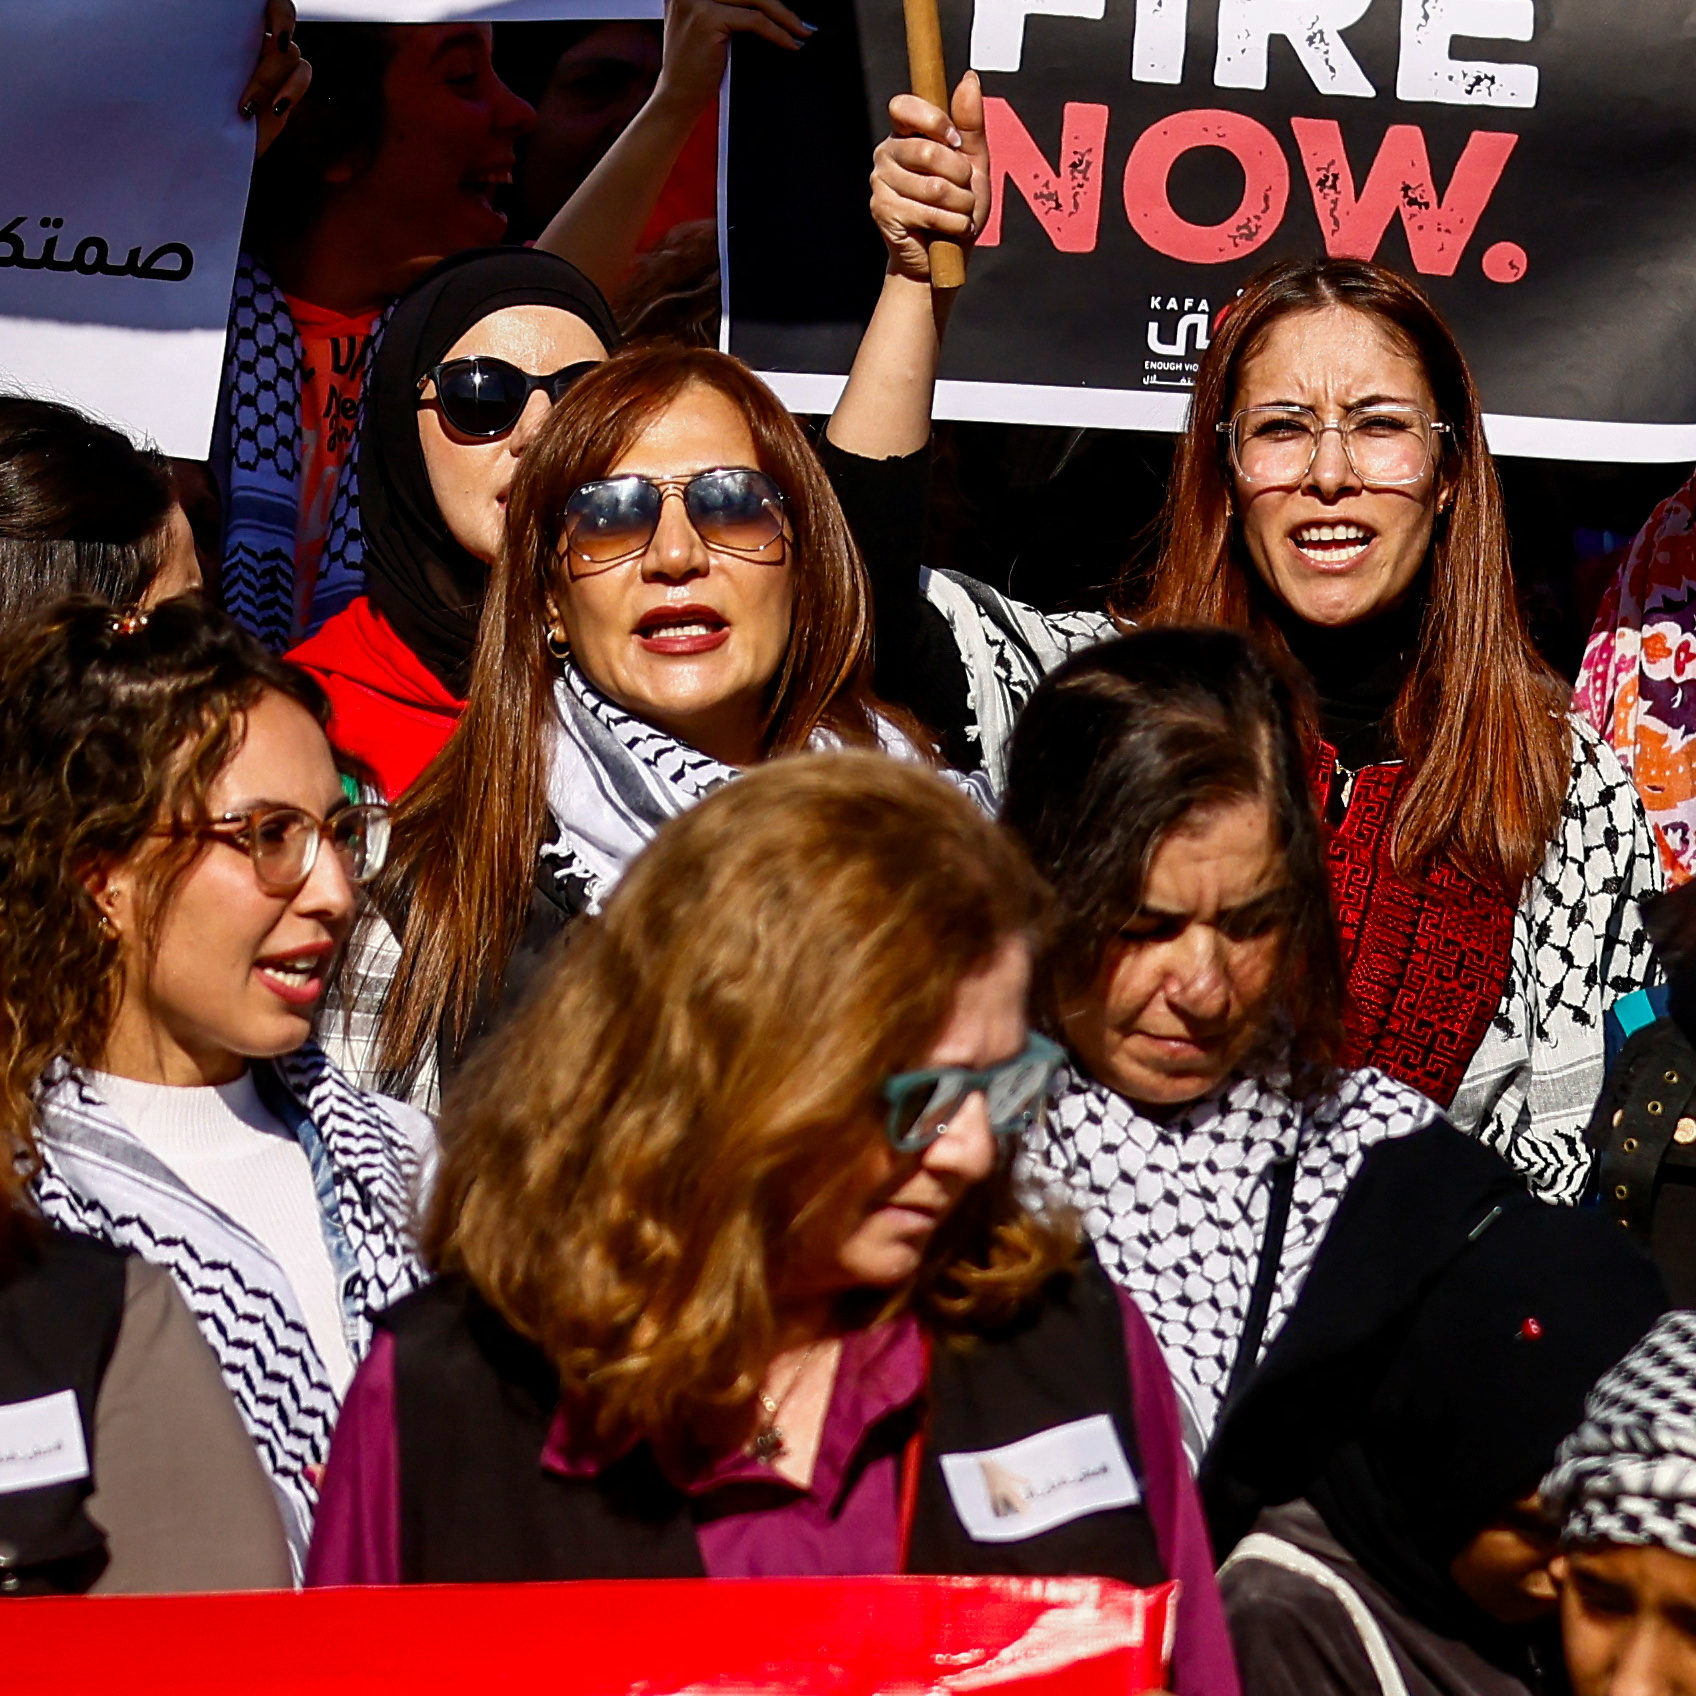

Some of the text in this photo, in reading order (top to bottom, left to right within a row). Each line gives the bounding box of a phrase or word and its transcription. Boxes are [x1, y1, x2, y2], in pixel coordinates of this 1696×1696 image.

[974, 96, 1528, 283] NOW.
[1150, 296, 1210, 312] KAFA
[1144, 360, 1183, 371] ENOUGH
